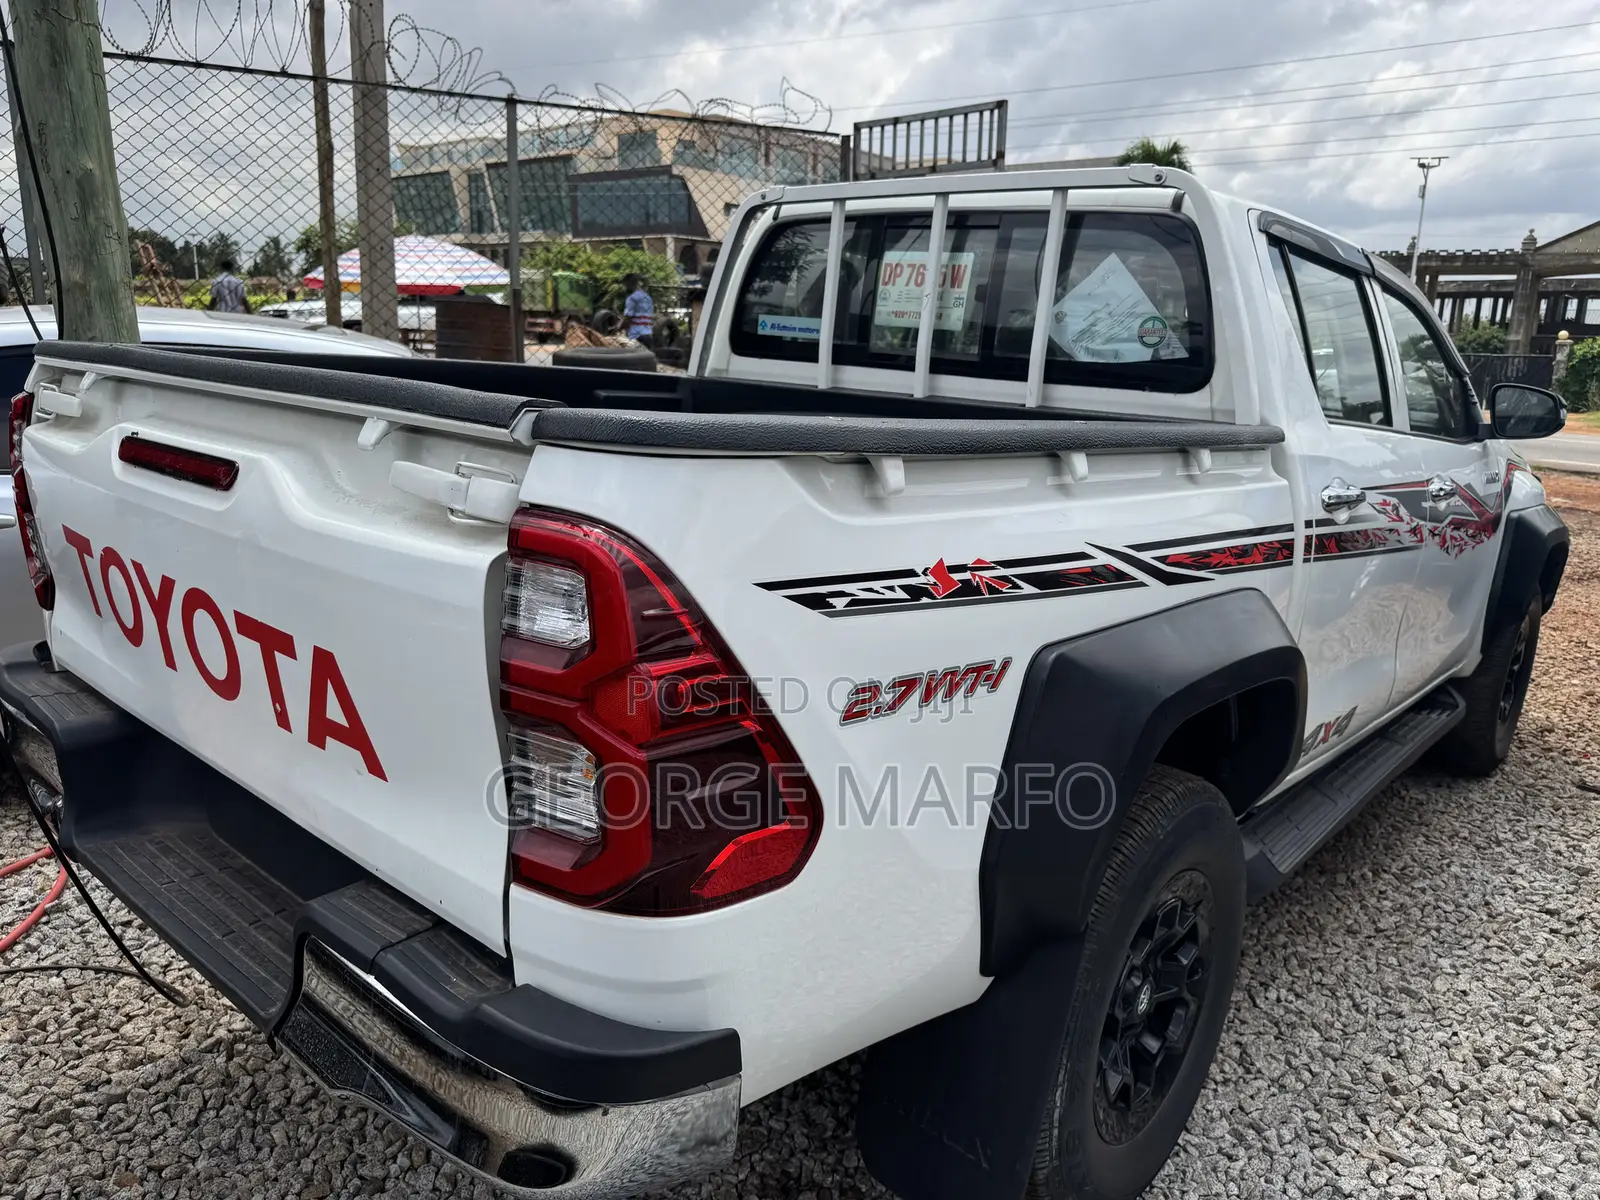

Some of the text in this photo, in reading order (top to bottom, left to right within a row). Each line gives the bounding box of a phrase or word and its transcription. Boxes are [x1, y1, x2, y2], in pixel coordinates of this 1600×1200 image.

[881, 263, 968, 289] DP 765 W
[62, 524, 388, 783] TOYOTA
